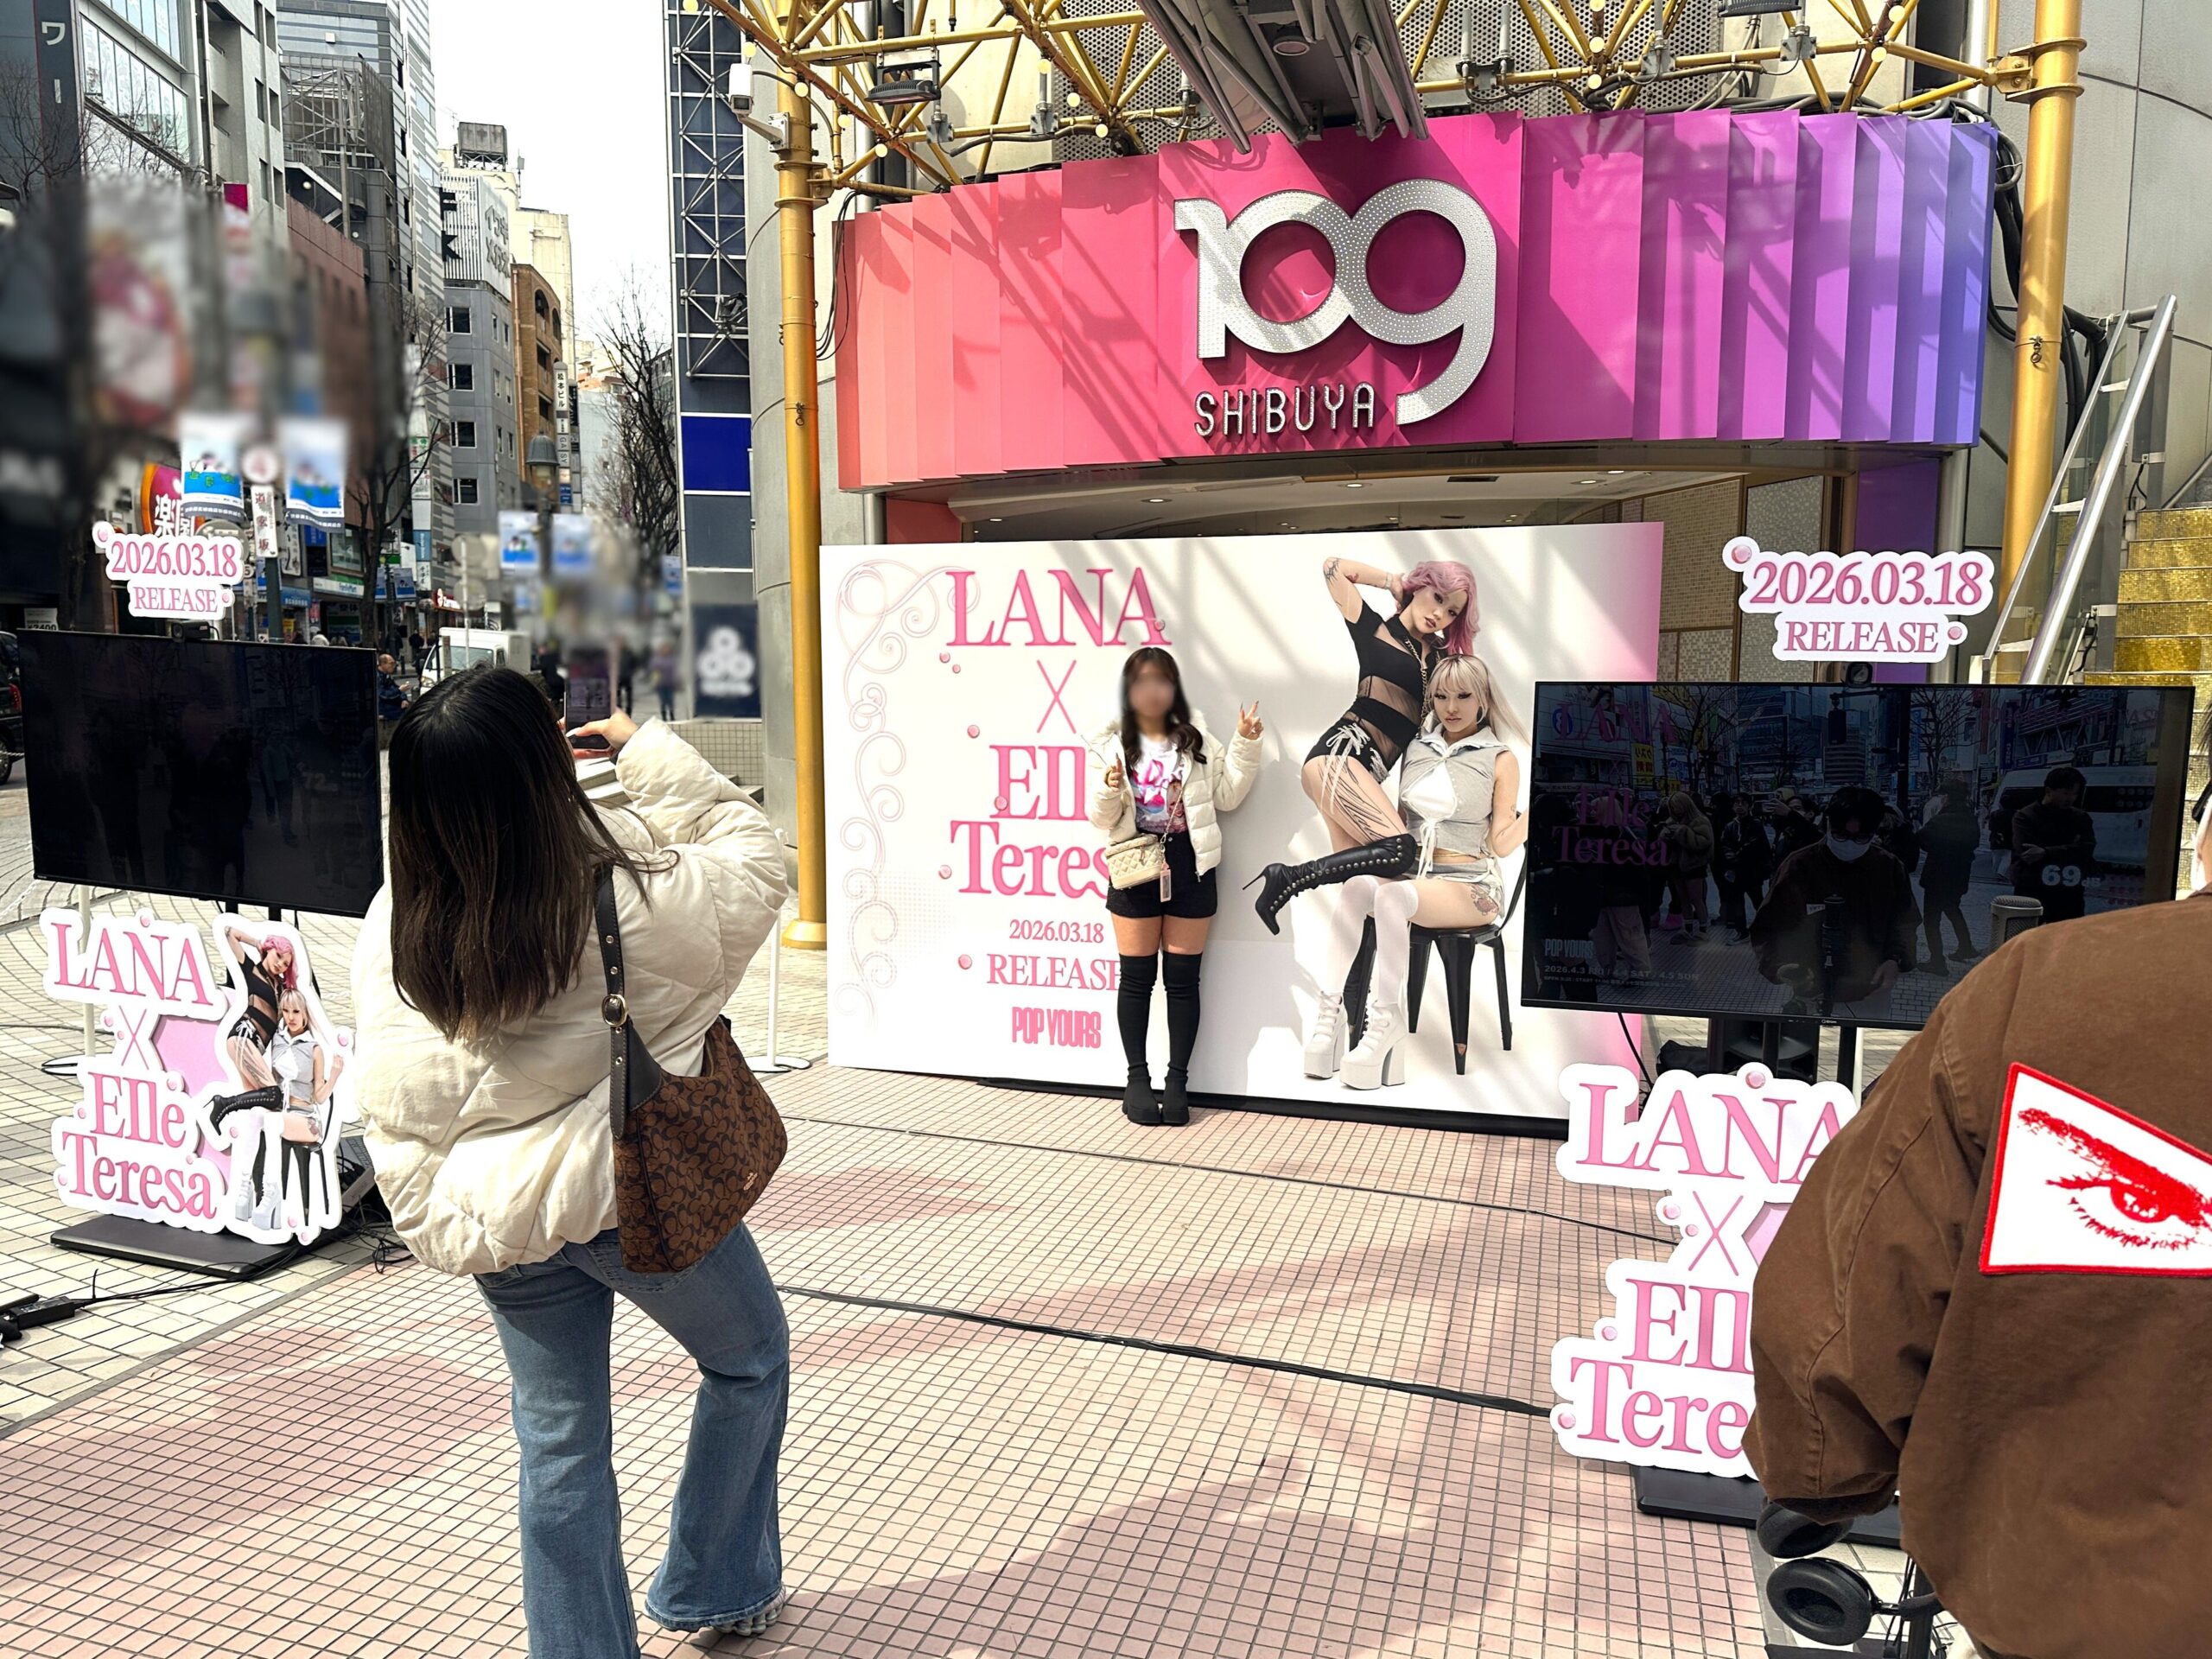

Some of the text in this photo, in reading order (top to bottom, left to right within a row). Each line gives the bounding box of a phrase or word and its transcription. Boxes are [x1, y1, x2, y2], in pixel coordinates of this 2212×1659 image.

[1174, 179, 1497, 425] 109
[1194, 383, 1375, 436] SHIBUYA
[111, 541, 238, 577] 2026.03.18
[1750, 560, 1984, 606] 2026.03.18
[133, 587, 219, 613] RELEASE
[945, 566, 1173, 648] LANA
[1783, 621, 1938, 653] RELEASE
[989, 745, 1090, 822] Ell
[950, 820, 1109, 900] Teres
[1551, 826, 1672, 868] Teresa
[2042, 865, 2082, 887] 69
[52, 922, 213, 1006] LANA
[1009, 918, 1104, 944] 2026.03.18
[1012, 1007, 1102, 1049] POP YOURS
[87, 1071, 185, 1149] Elle
[1576, 1083, 1843, 1185] LANA
[62, 1131, 217, 1220] Teresa
[1623, 1279, 1755, 1376] Ell
[1570, 1357, 1751, 1459] Tere
